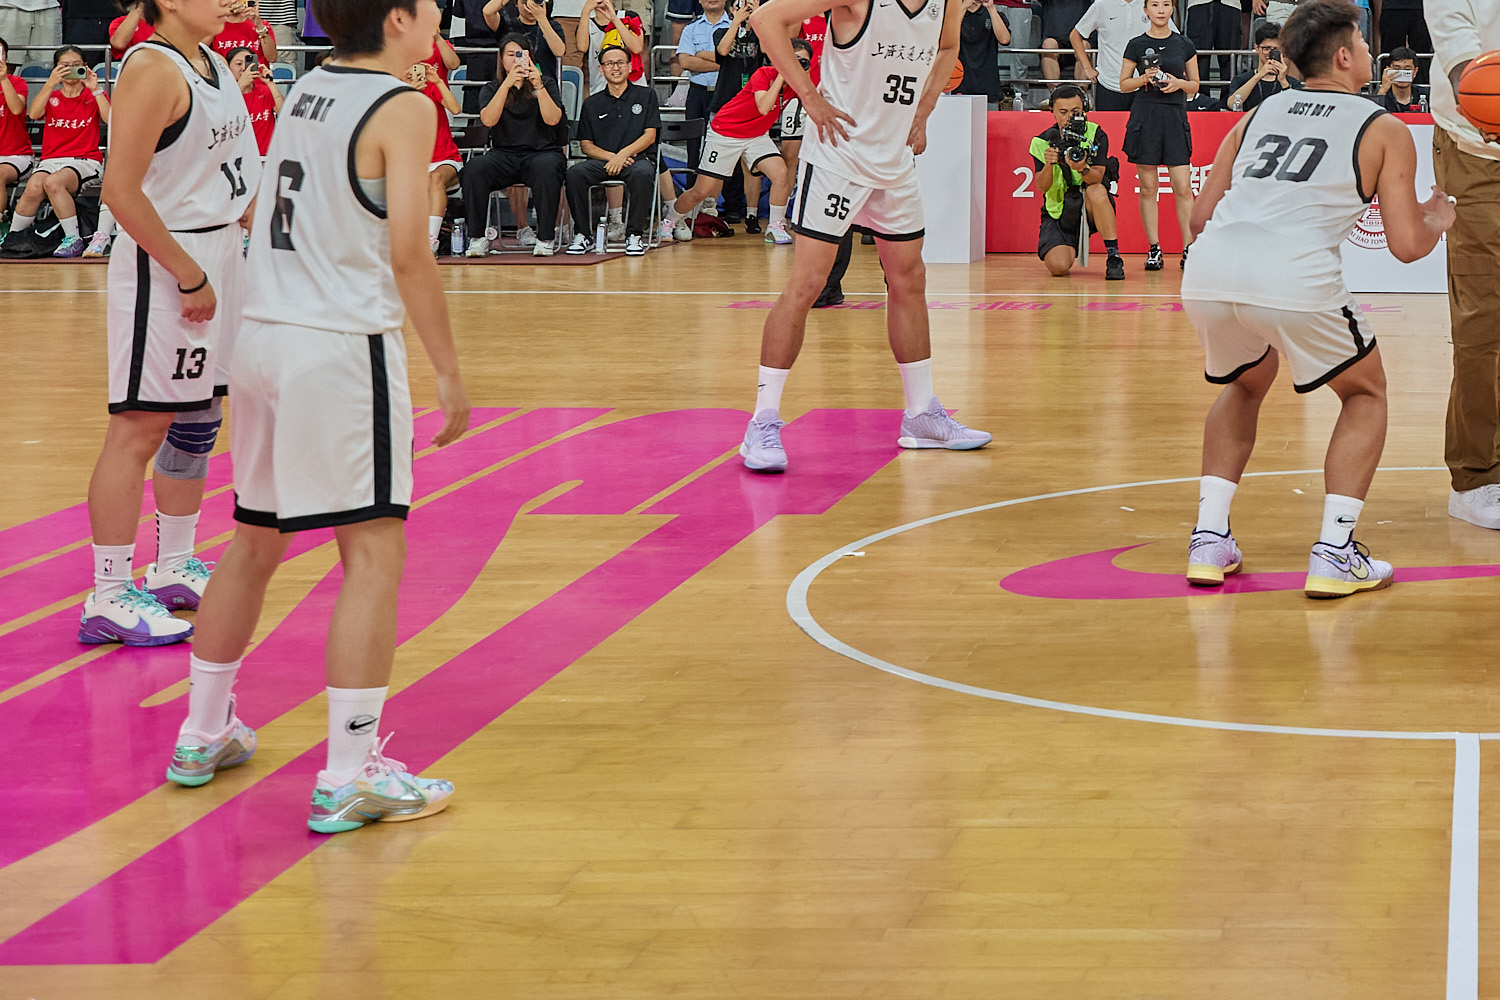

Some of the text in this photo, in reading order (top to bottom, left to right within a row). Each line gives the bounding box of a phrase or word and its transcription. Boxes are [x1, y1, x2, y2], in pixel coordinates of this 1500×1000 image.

[883, 74, 917, 106] 35
[1288, 101, 1337, 118] JUST DO IT
[708, 151, 718, 164] 8
[1242, 134, 1329, 183] 30
[271, 159, 305, 252] 6
[824, 194, 851, 221] 35
[171, 347, 207, 381] 13
